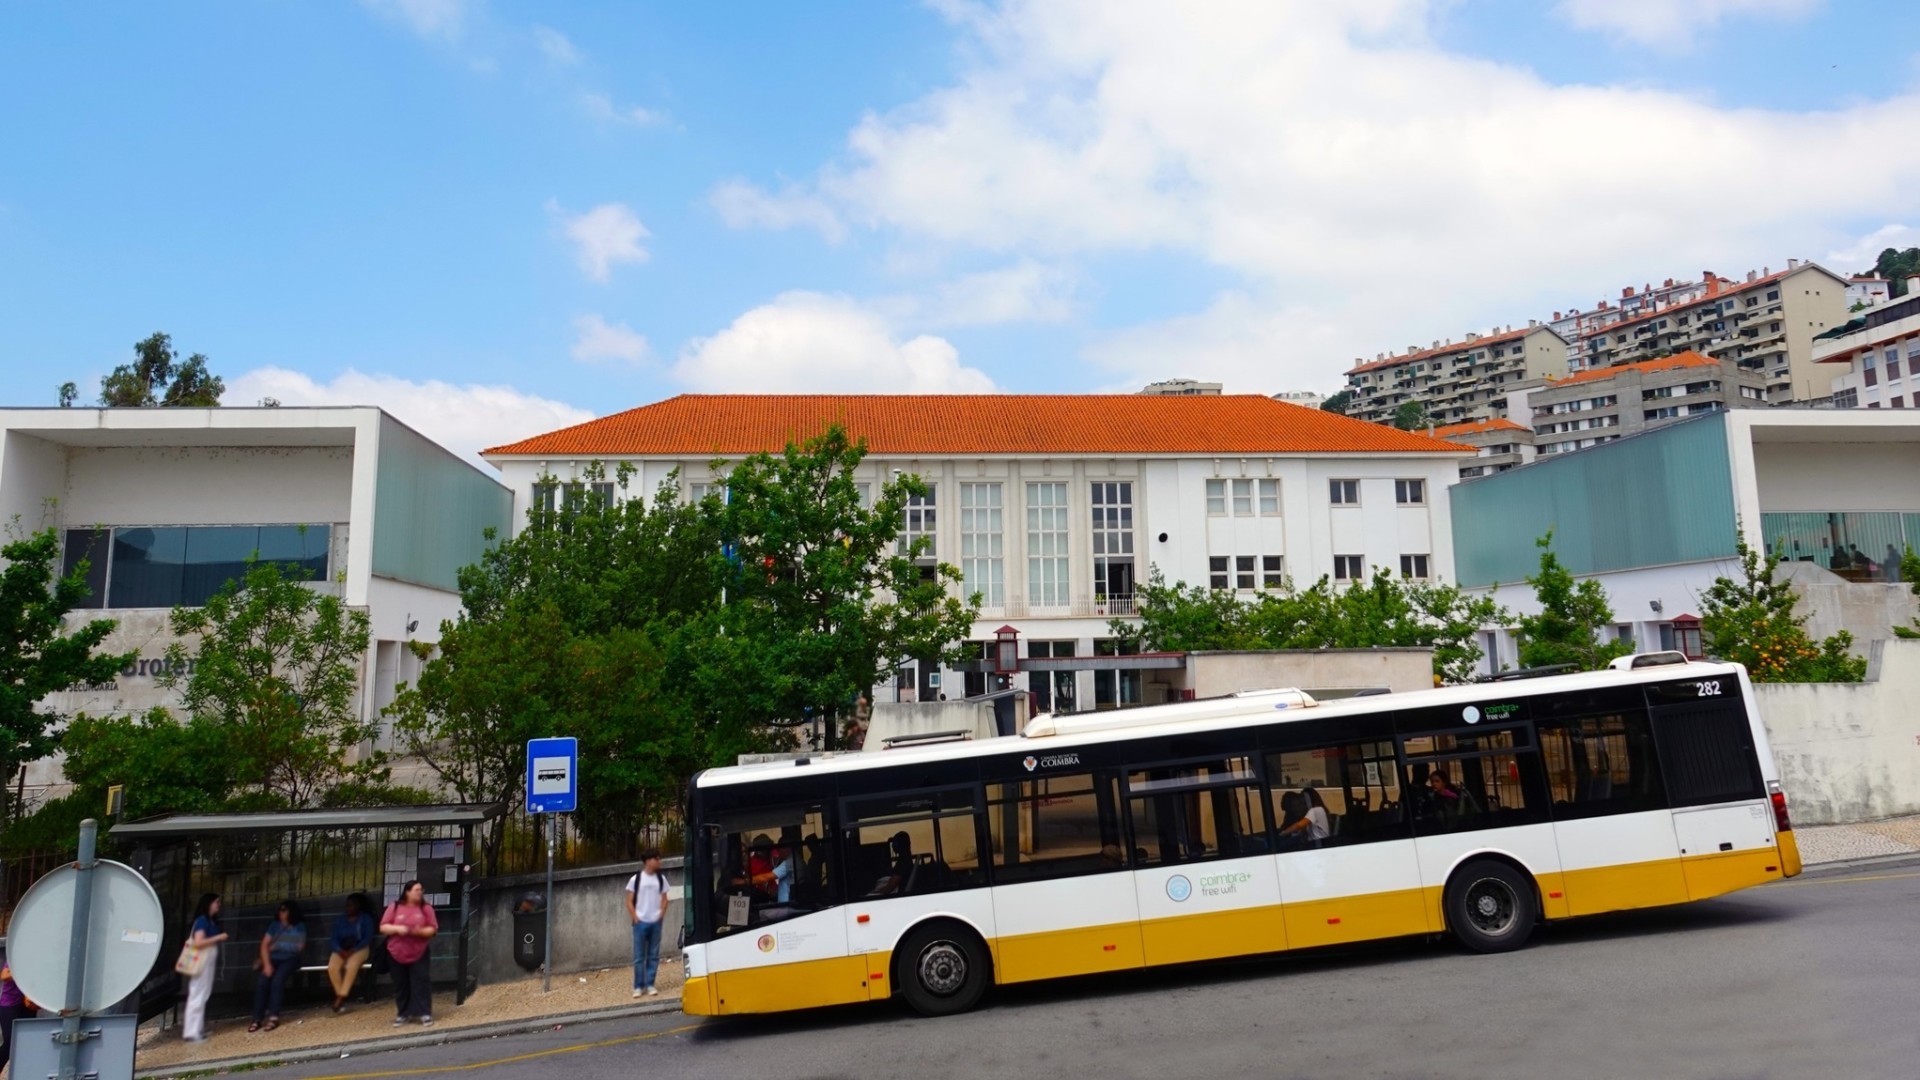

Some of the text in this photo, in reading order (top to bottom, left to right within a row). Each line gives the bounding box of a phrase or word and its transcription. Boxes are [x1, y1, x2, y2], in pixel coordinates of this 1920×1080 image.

[1696, 681, 1722, 696] 282
[1041, 757, 1079, 767] COIMBRA
[1202, 884, 1236, 896] free wifi
[734, 900, 746, 908] 103
